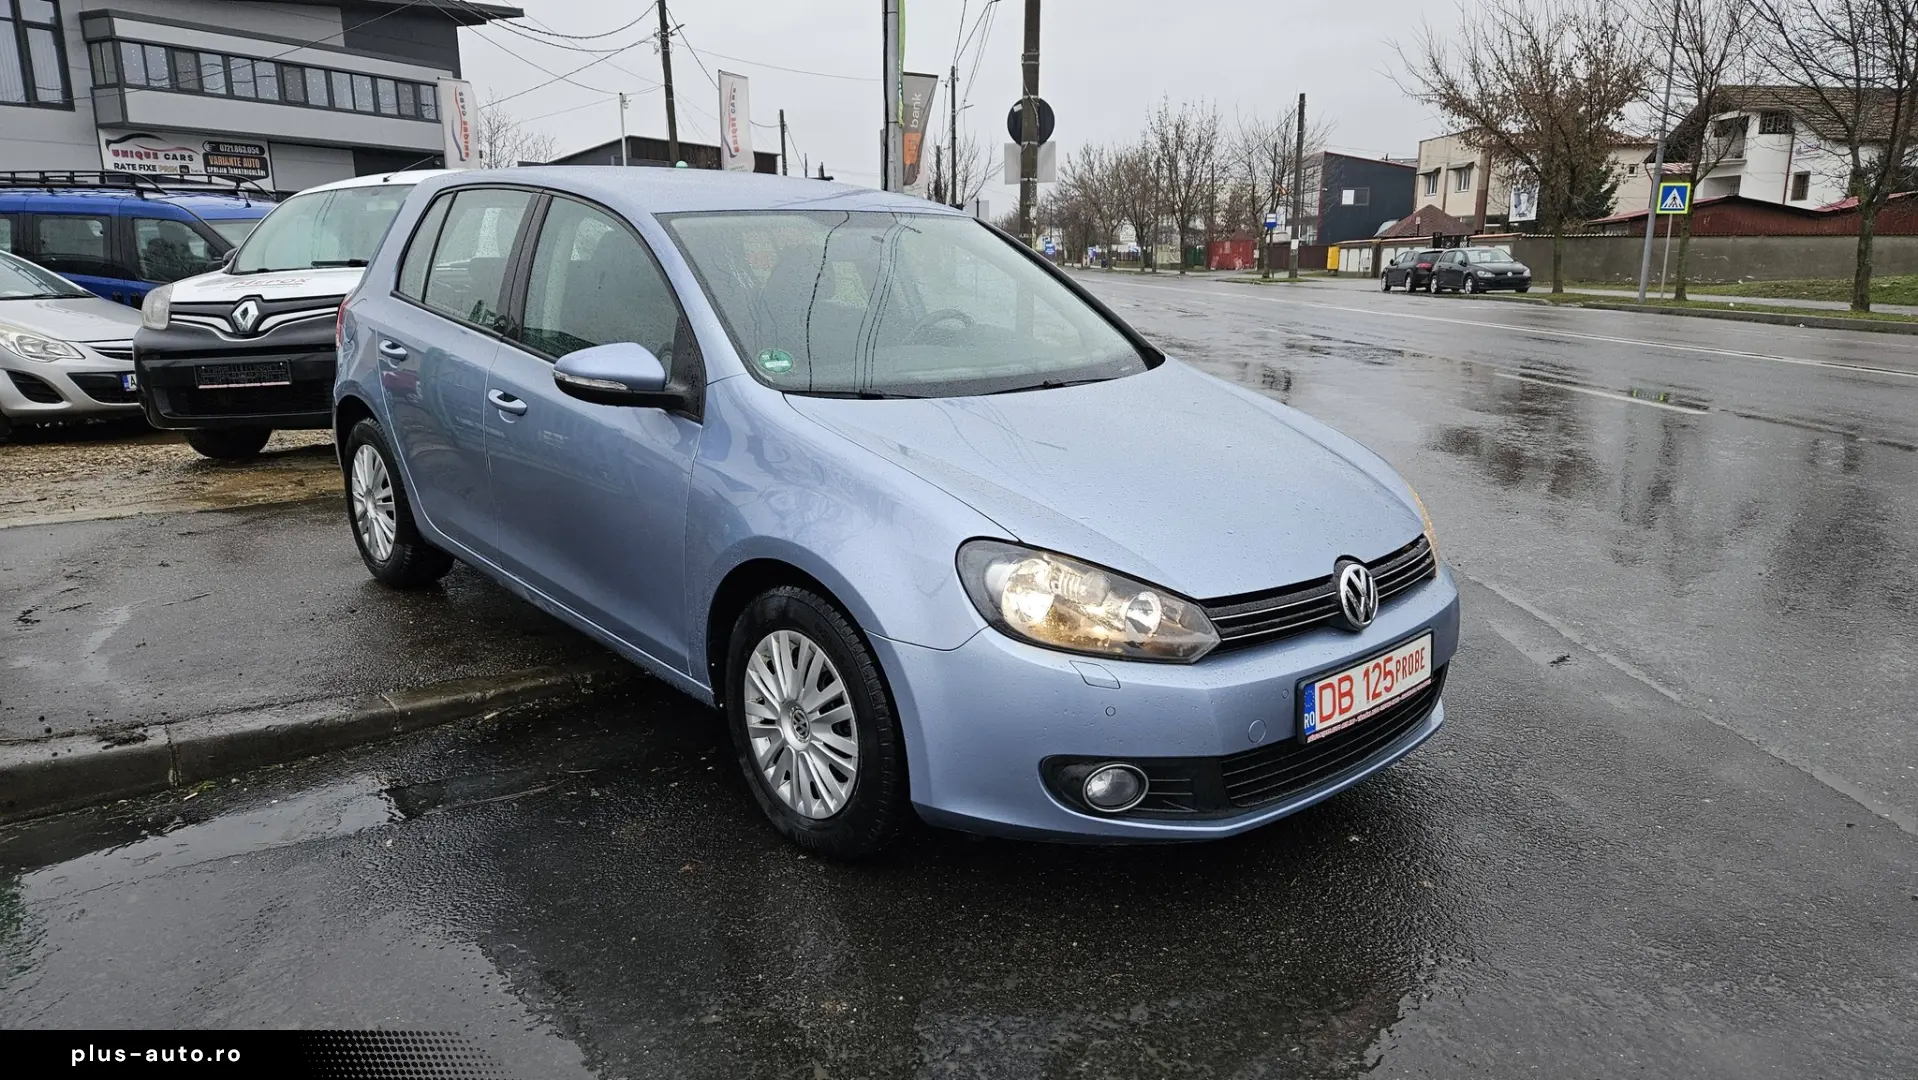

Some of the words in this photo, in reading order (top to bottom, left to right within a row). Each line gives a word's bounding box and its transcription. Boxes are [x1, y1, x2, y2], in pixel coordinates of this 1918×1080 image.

[458, 91, 467, 116] CARS
[909, 92, 922, 129] bank
[462, 121, 470, 158] UNIQUE
[111, 149, 159, 161] UNIQUE
[163, 153, 194, 162] CARS
[208, 155, 242, 167] VARIANTE
[243, 157, 260, 168] AUTO
[113, 162, 137, 171] RATE
[138, 164, 157, 172] FIXE
[1318, 674, 1354, 724] DB
[1362, 655, 1395, 703] 125
[1395, 646, 1426, 684] PROBE
[1304, 710, 1315, 730] RO
